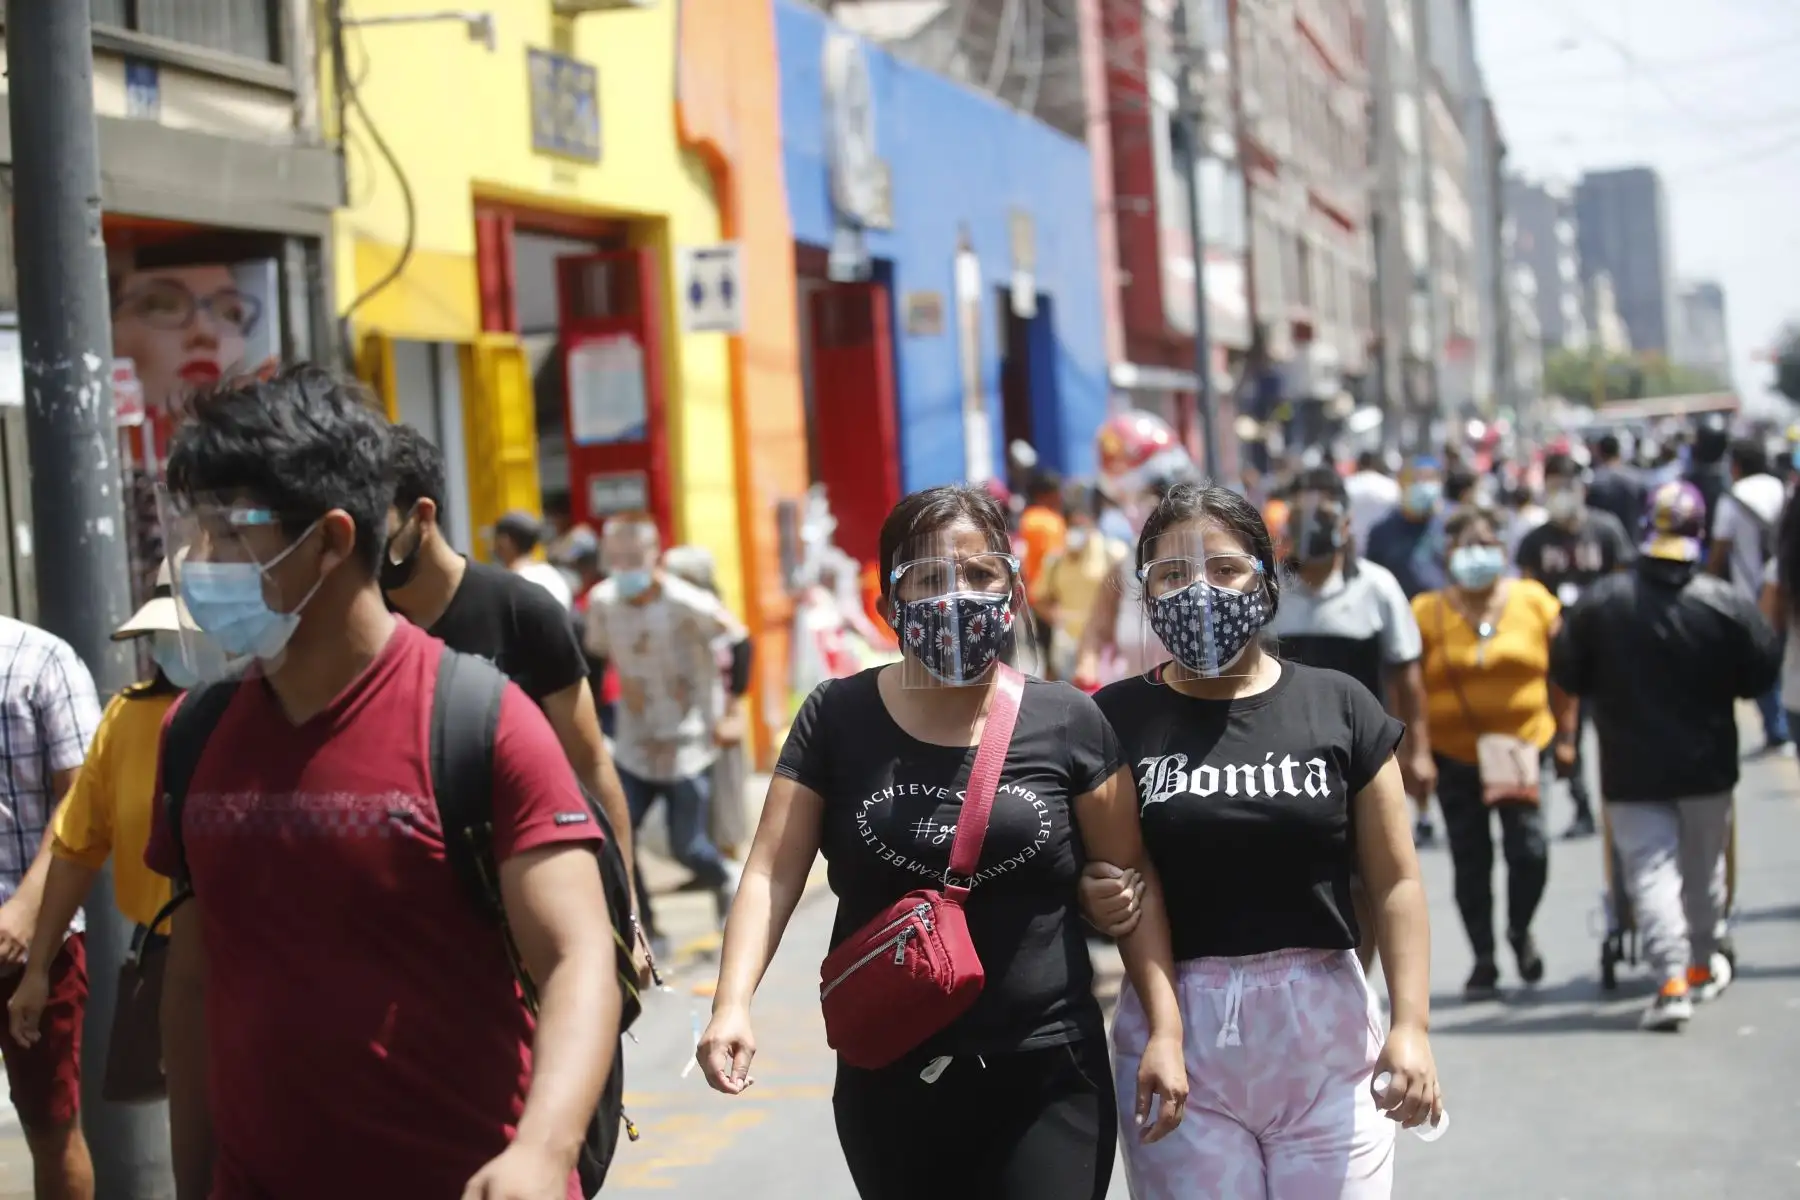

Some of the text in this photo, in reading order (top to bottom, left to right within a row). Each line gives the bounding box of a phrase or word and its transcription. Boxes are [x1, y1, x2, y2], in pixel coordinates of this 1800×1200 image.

[862, 783, 950, 810] ACHIEVE
[1138, 752, 1331, 818] Bonita
[856, 810, 907, 867] BELIEVE
